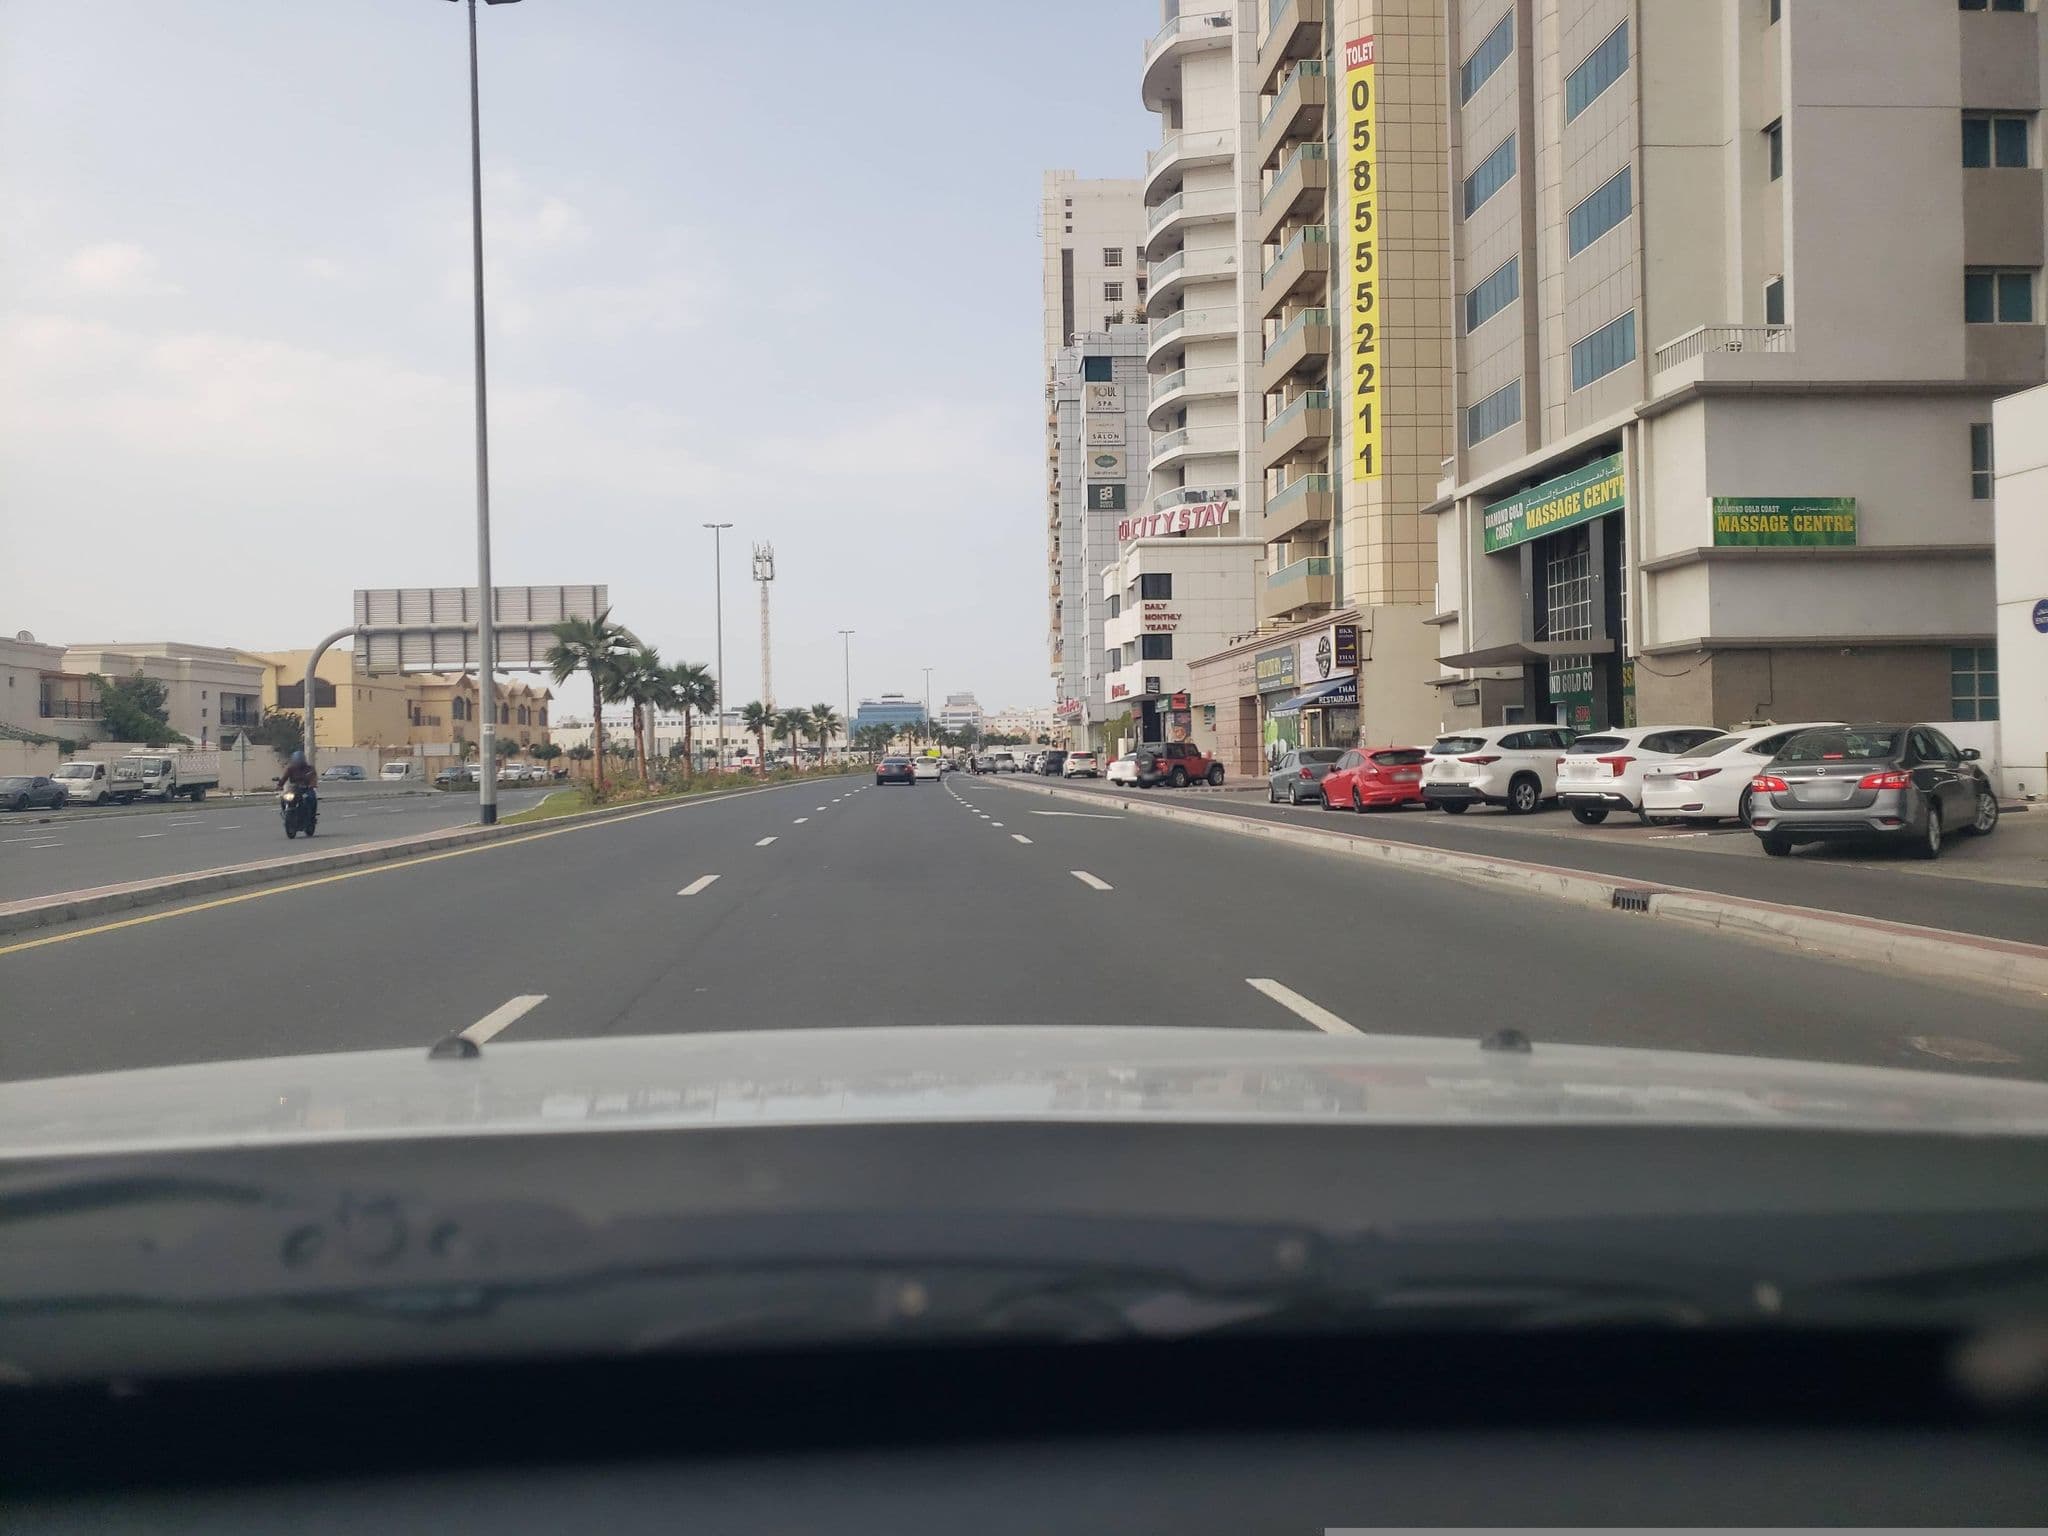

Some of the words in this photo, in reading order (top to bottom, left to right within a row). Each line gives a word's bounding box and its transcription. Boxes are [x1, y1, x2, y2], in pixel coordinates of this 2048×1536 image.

[1352, 80, 1375, 474] 0585552211
[1485, 507, 1509, 529] DIAMOND
[1509, 503, 1523, 521] GOLD
[1526, 491, 1581, 530] MASSAGE
[1717, 505, 1743, 513] DIAMOND
[1745, 505, 1760, 513] GOLD
[1761, 505, 1780, 513] COAST
[1496, 522, 1513, 540] COAST
[1718, 515, 1789, 532] MASSAGE
[1793, 515, 1854, 532] CENTRE
[1145, 623, 1177, 631] YEARLY
[1562, 673, 1580, 693] GOLD
[1319, 694, 1356, 704] RESTAURANT
